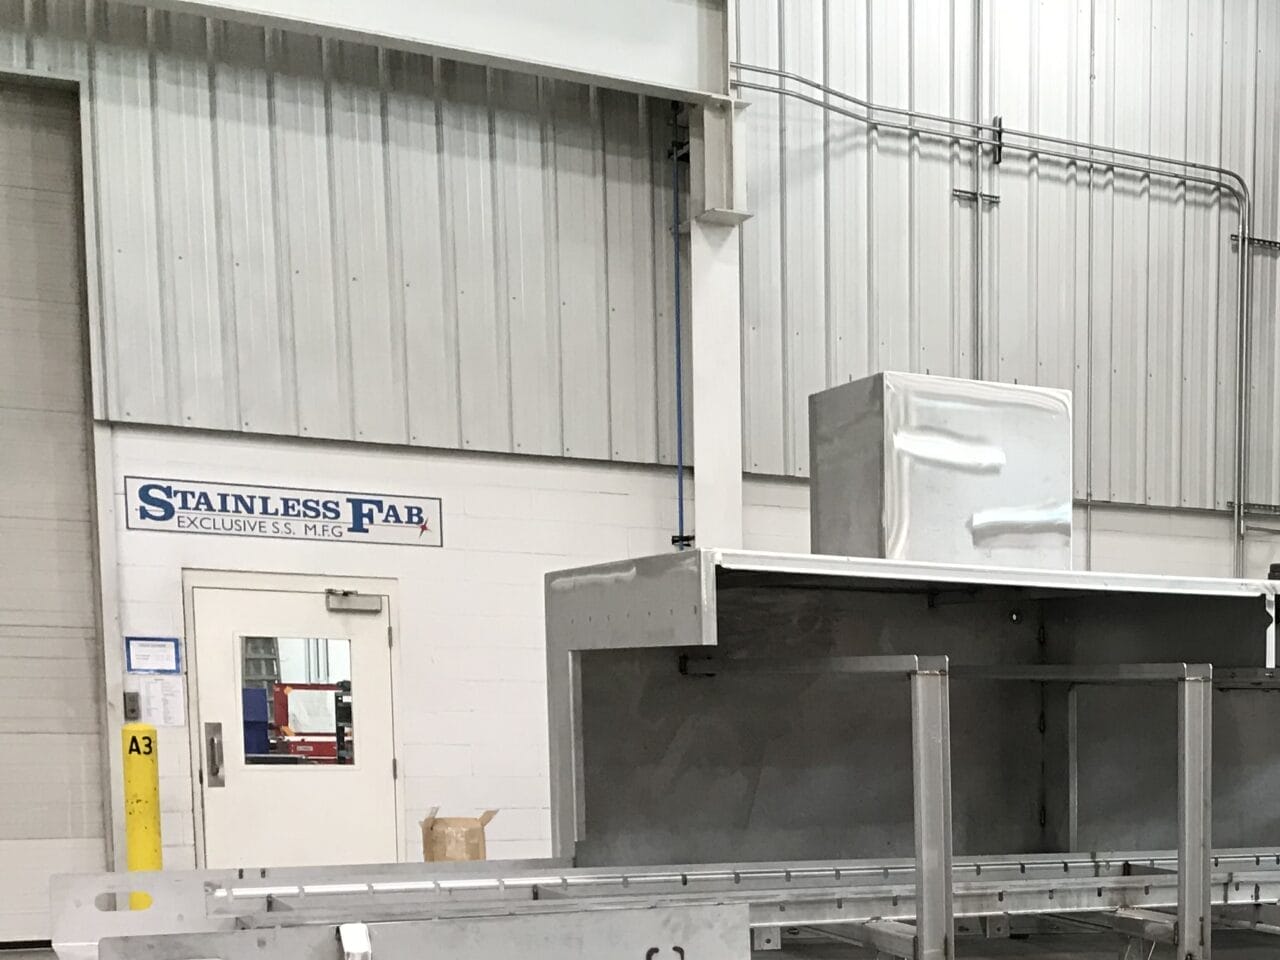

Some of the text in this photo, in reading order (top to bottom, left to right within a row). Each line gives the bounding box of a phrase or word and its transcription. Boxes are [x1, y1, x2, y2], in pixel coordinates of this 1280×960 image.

[138, 484, 424, 533] STAINLESS FAB
[177, 515, 343, 539] EXCLUSIVE S.S. M.F.G
[128, 735, 153, 756] A3
